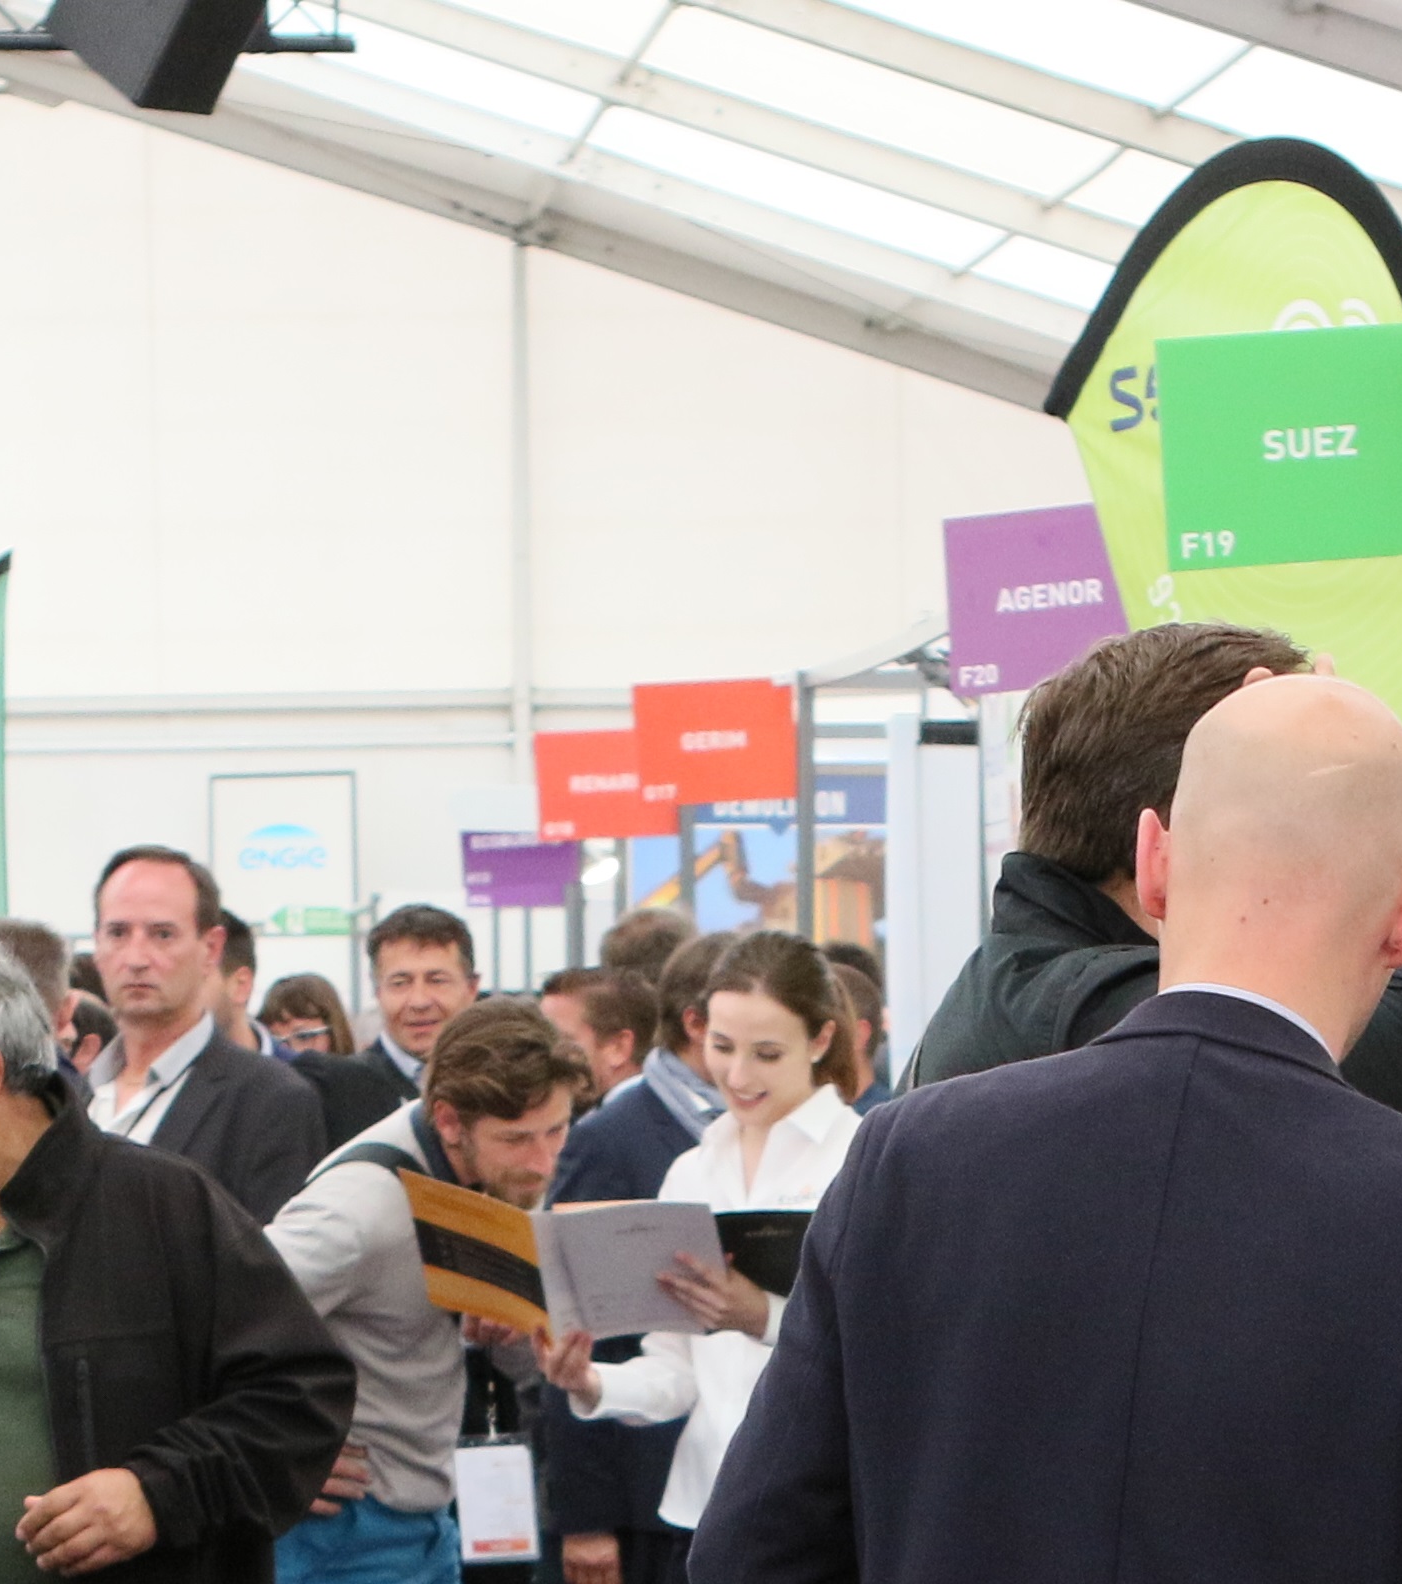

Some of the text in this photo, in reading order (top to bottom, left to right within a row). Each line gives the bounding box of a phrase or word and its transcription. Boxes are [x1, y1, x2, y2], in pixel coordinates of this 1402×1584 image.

[1262, 425, 1358, 461] SUEZ
[1180, 530, 1235, 560] F19
[997, 578, 1103, 612] AGENOR
